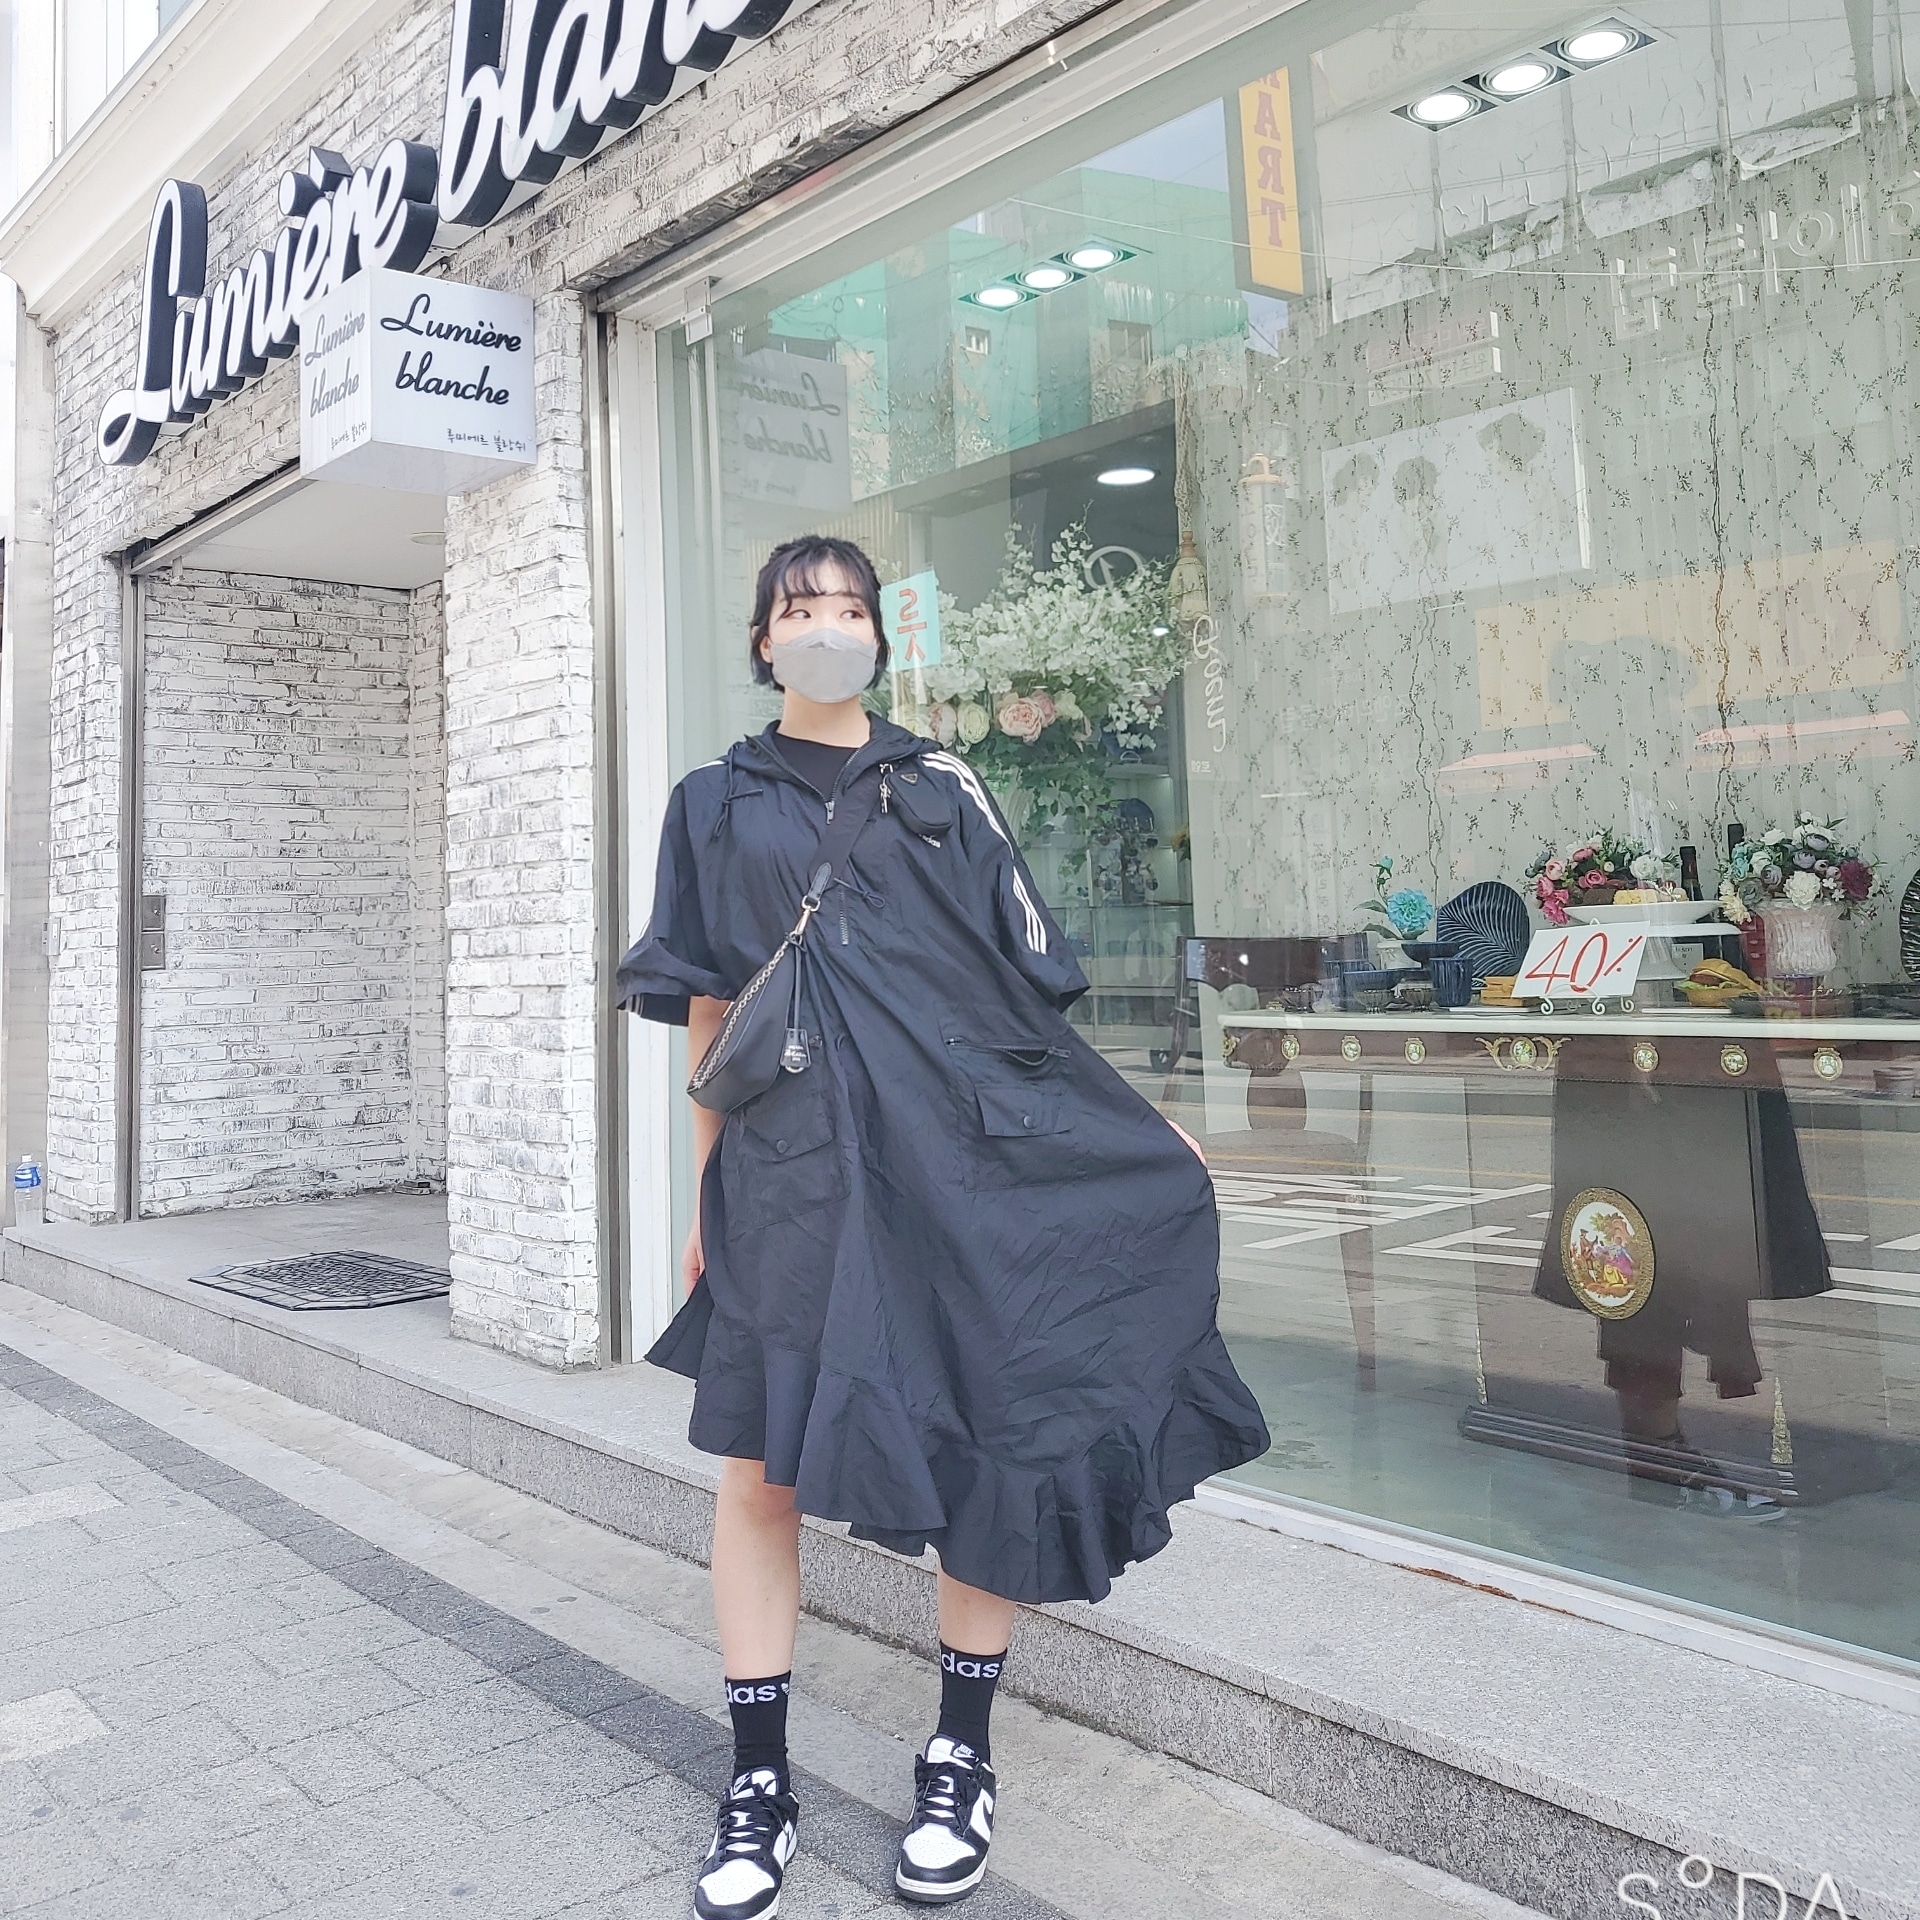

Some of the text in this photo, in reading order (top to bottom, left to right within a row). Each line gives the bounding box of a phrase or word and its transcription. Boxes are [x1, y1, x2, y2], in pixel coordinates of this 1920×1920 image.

[437, 0, 794, 227] blan
[303, 311, 366, 367] Lumière
[380, 293, 522, 352] Lumière
[310, 357, 360, 418] blanche
[395, 351, 510, 405] blanche
[447, 428, 489, 446] 루미에르
[1525, 932, 1643, 995] 40%
